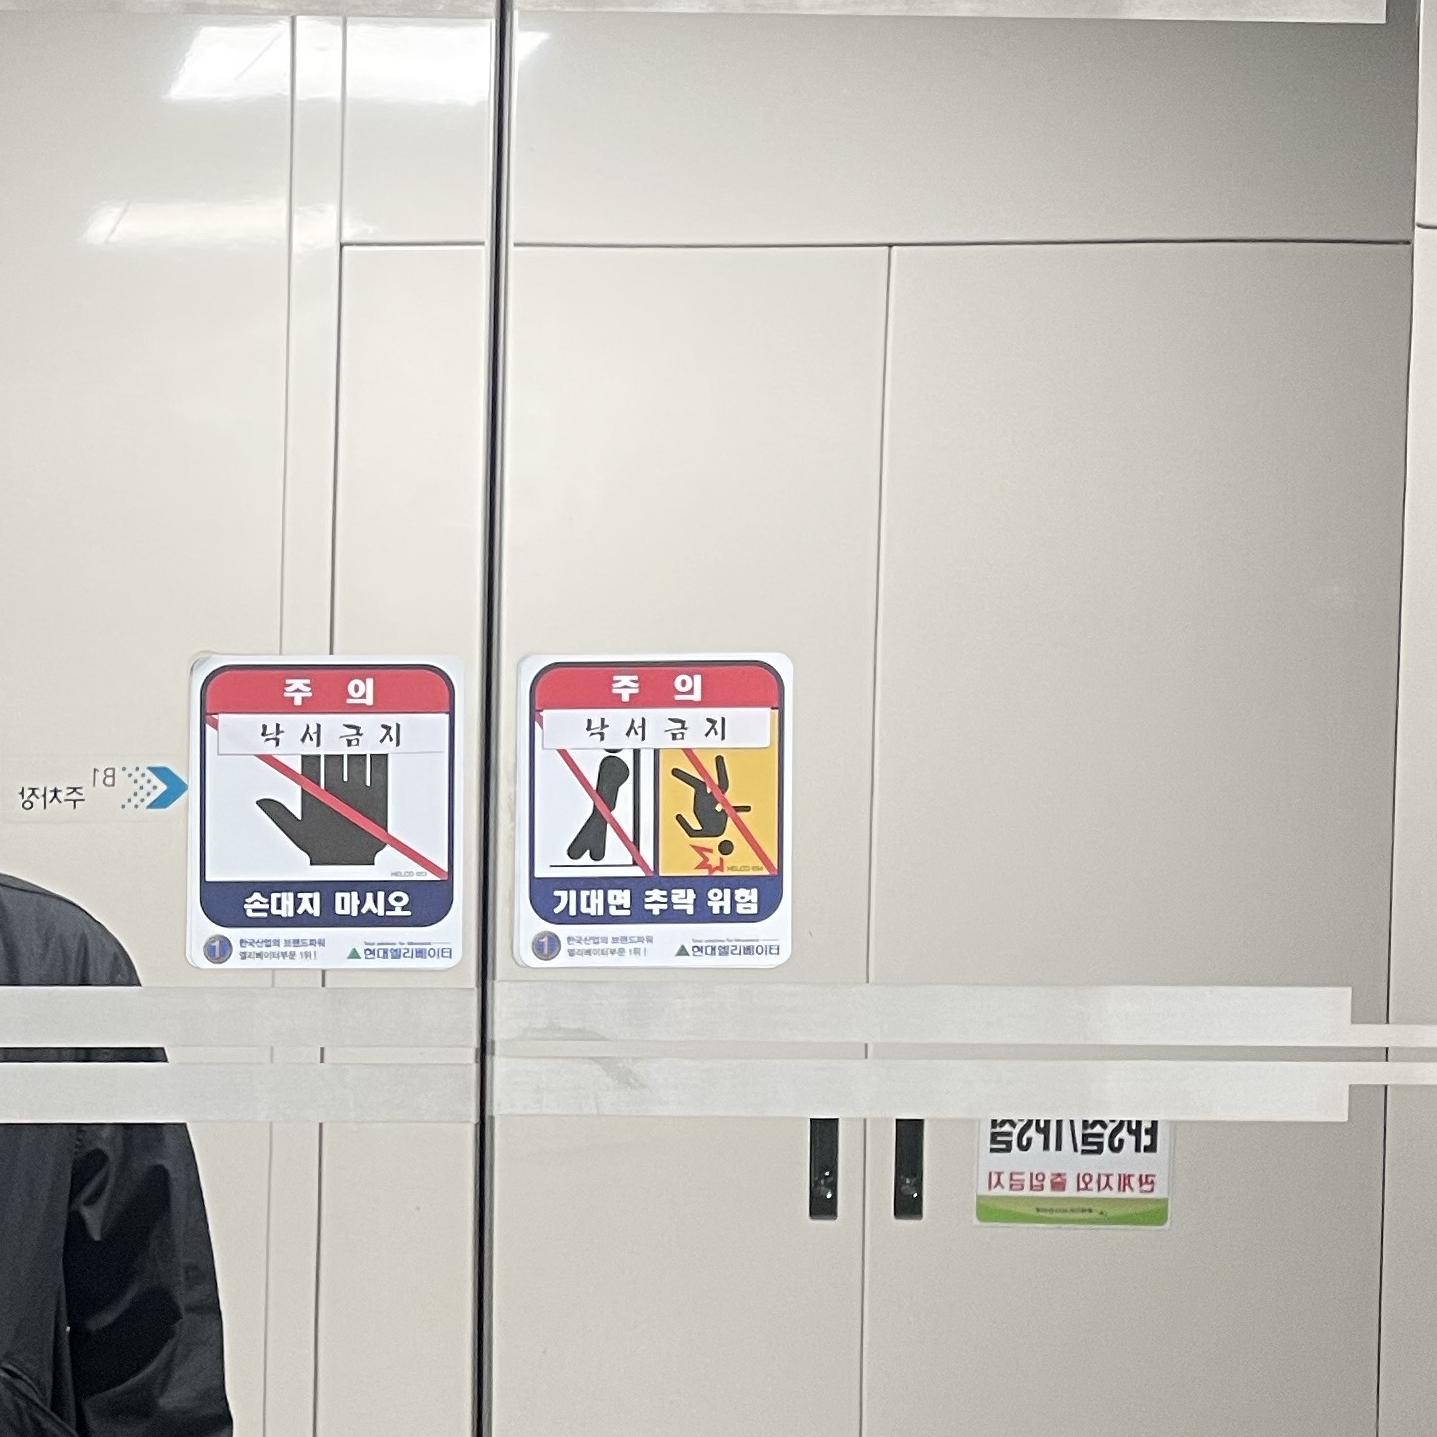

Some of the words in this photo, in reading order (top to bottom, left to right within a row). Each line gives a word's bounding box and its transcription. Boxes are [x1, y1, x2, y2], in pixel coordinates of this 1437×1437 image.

[243, 891, 321, 918] 손대지
[334, 891, 412, 917] 마시오
[553, 888, 632, 916] 기대면
[644, 888, 697, 915] 추락
[707, 887, 759, 915] 위험
[363, 947, 453, 960] 현대엘리베이터
[691, 944, 780, 957] 현대엘리베이터
